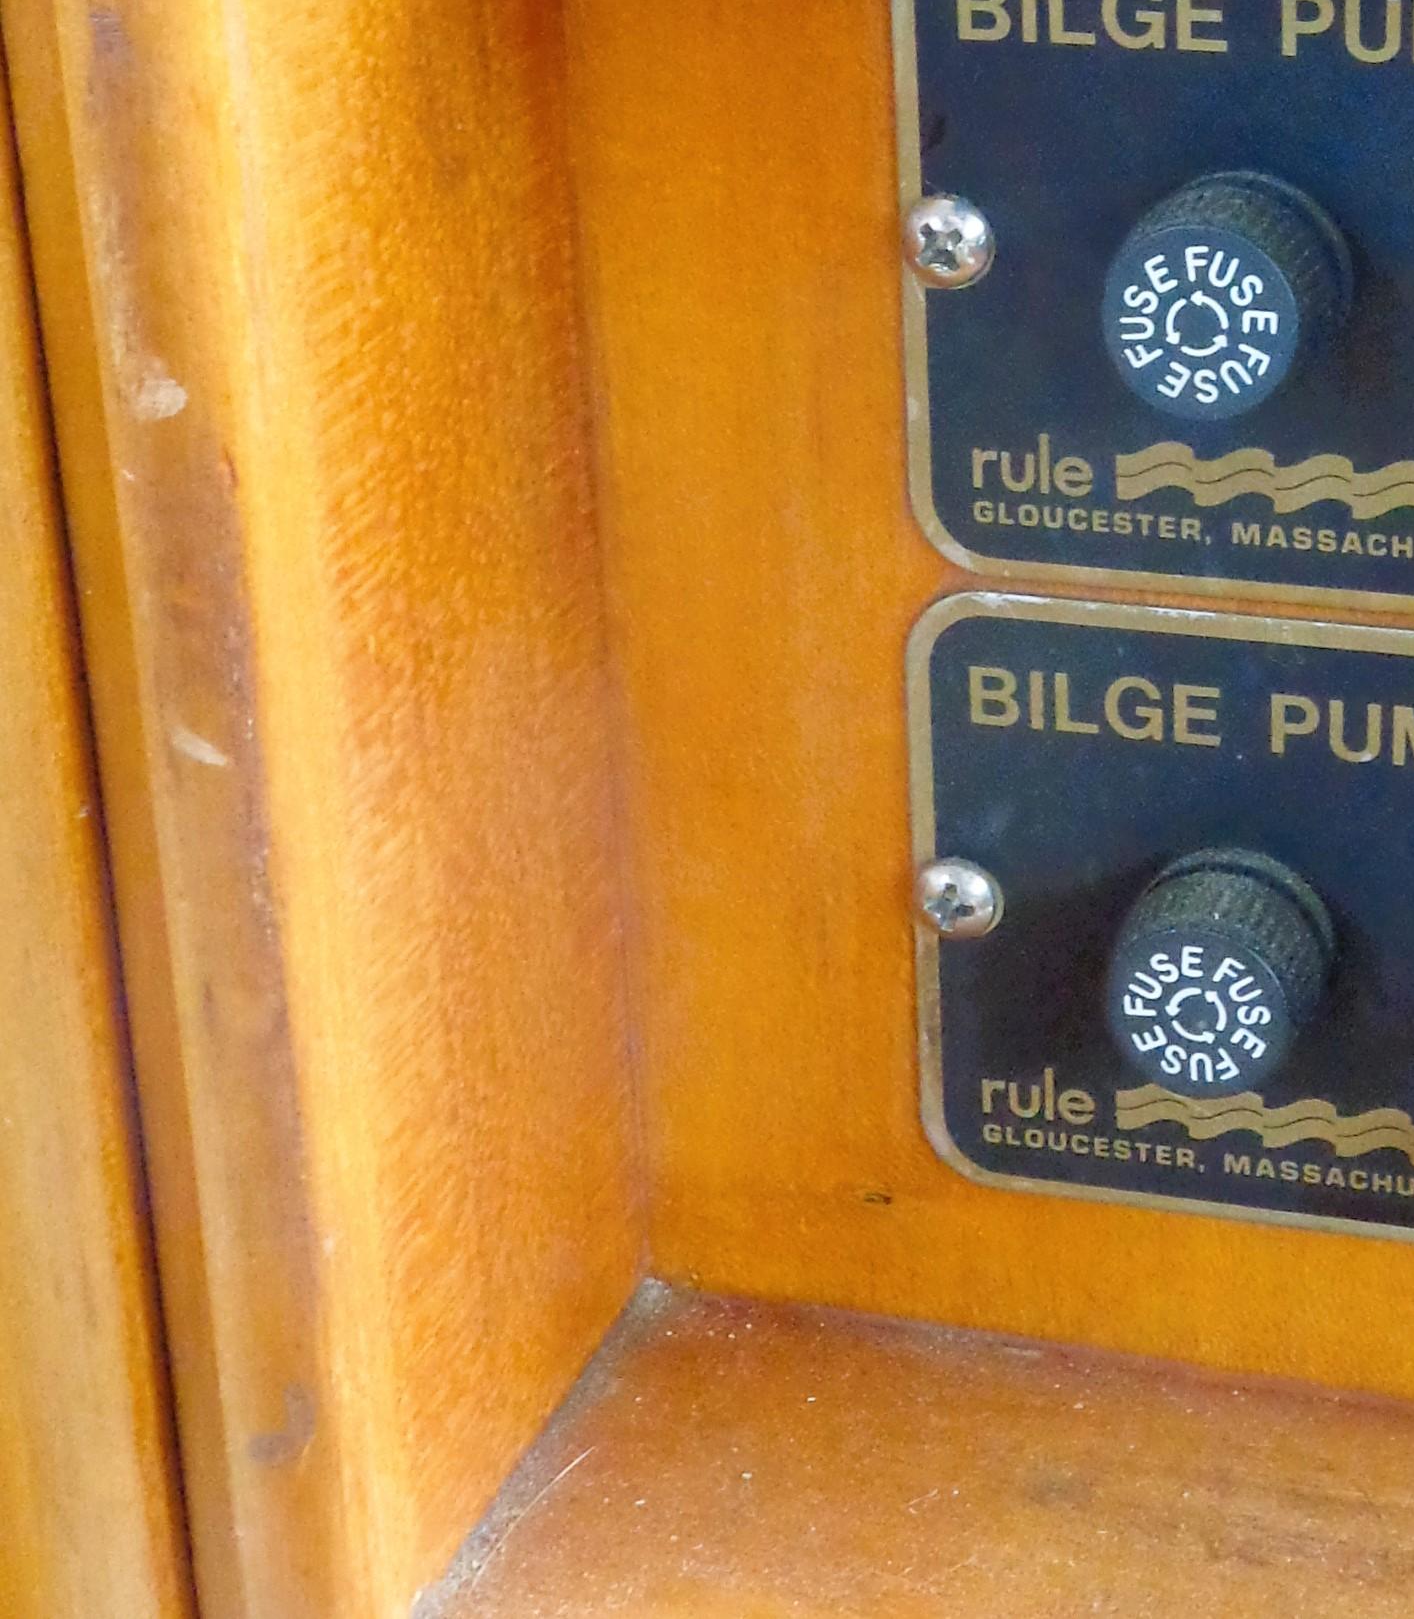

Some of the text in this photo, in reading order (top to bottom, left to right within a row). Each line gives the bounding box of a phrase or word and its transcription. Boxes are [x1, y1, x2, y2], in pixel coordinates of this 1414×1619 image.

[1118, 253, 1180, 370] FUSE
[1185, 245, 1279, 336] FUSE
[1156, 341, 1271, 404] FUSE
[971, 434, 1093, 497] rule
[972, 501, 1213, 546] GLOUCESTER,
[968, 665, 1222, 748] BILGE
[1124, 945, 1203, 1018] FUSE
[1212, 956, 1271, 1059] FUSE
[1132, 1025, 1240, 1082] FUSE
[980, 1067, 1096, 1126] rule
[982, 1123, 1206, 1172] GLOUCESTER,
